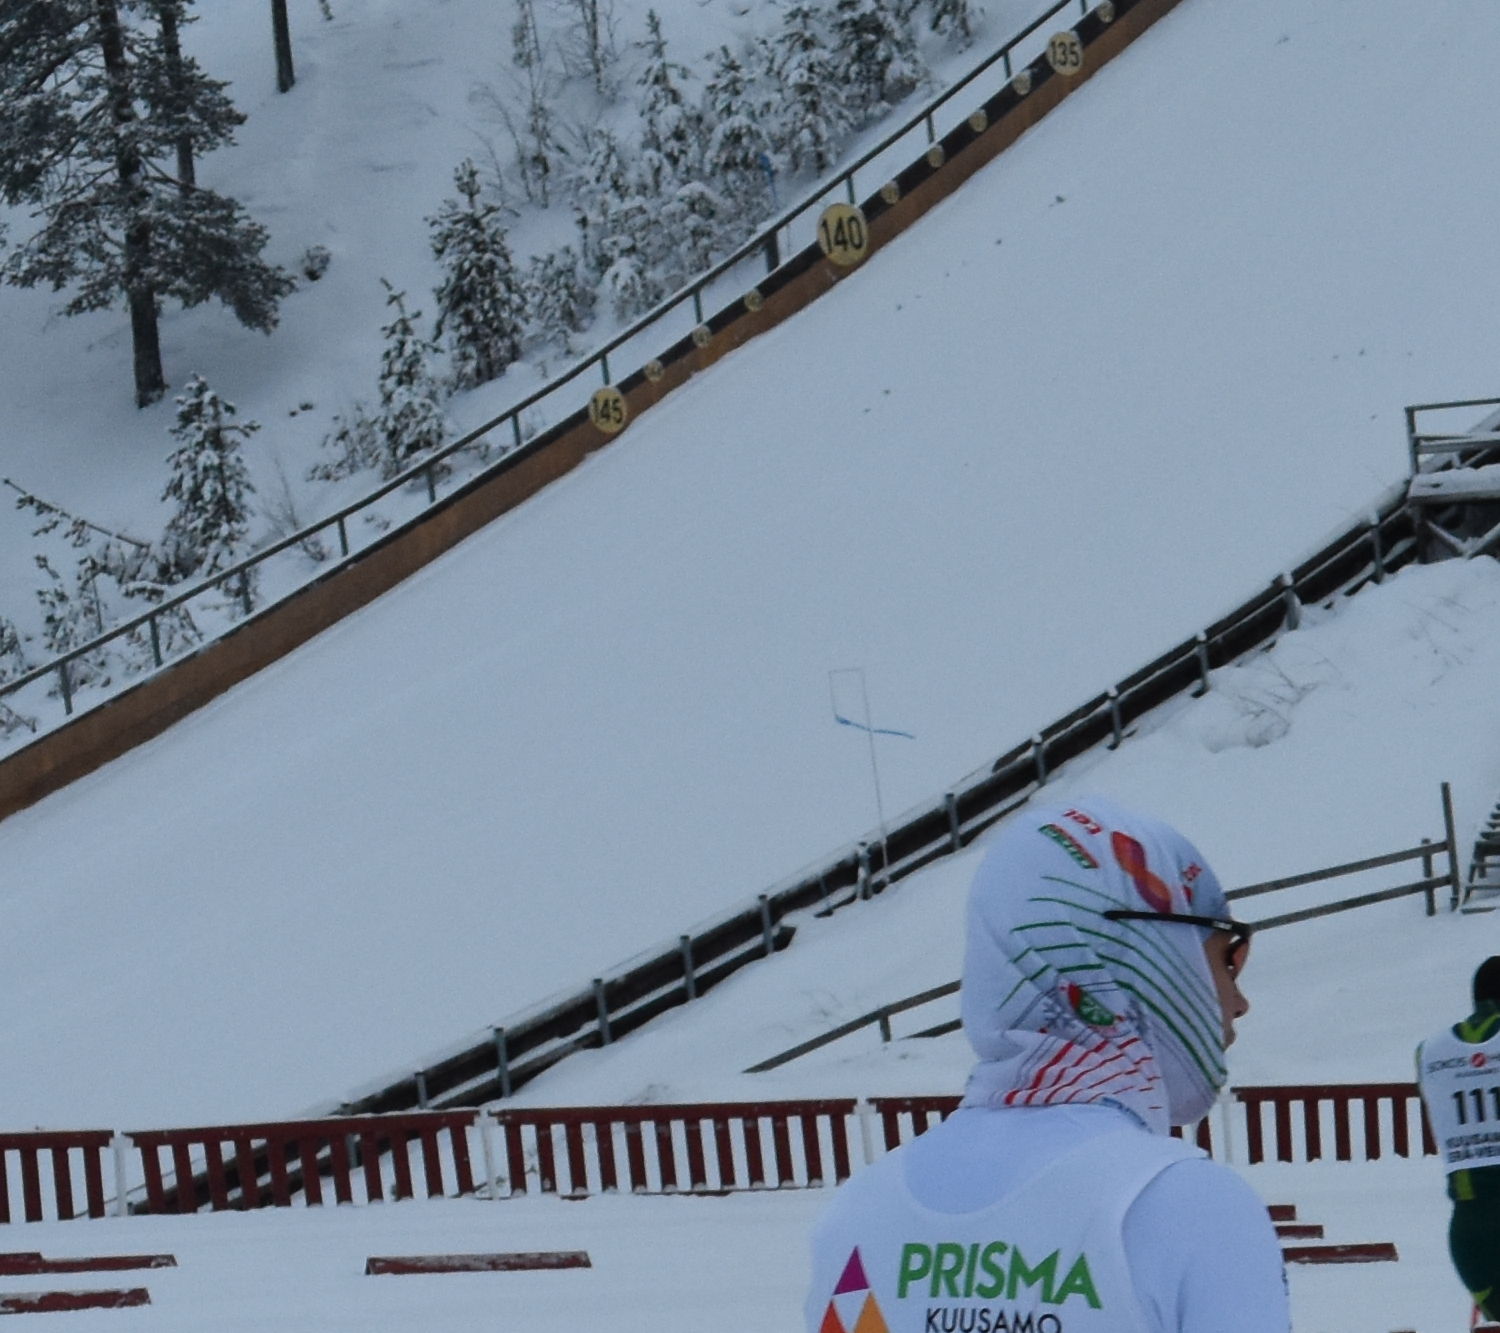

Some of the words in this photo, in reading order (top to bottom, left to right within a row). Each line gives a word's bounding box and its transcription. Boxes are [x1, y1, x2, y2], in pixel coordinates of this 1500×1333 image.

[1050, 40, 1081, 68] 135
[821, 214, 863, 254] 140
[591, 396, 623, 427] 145
[896, 1240, 1103, 1309] PRISMA
